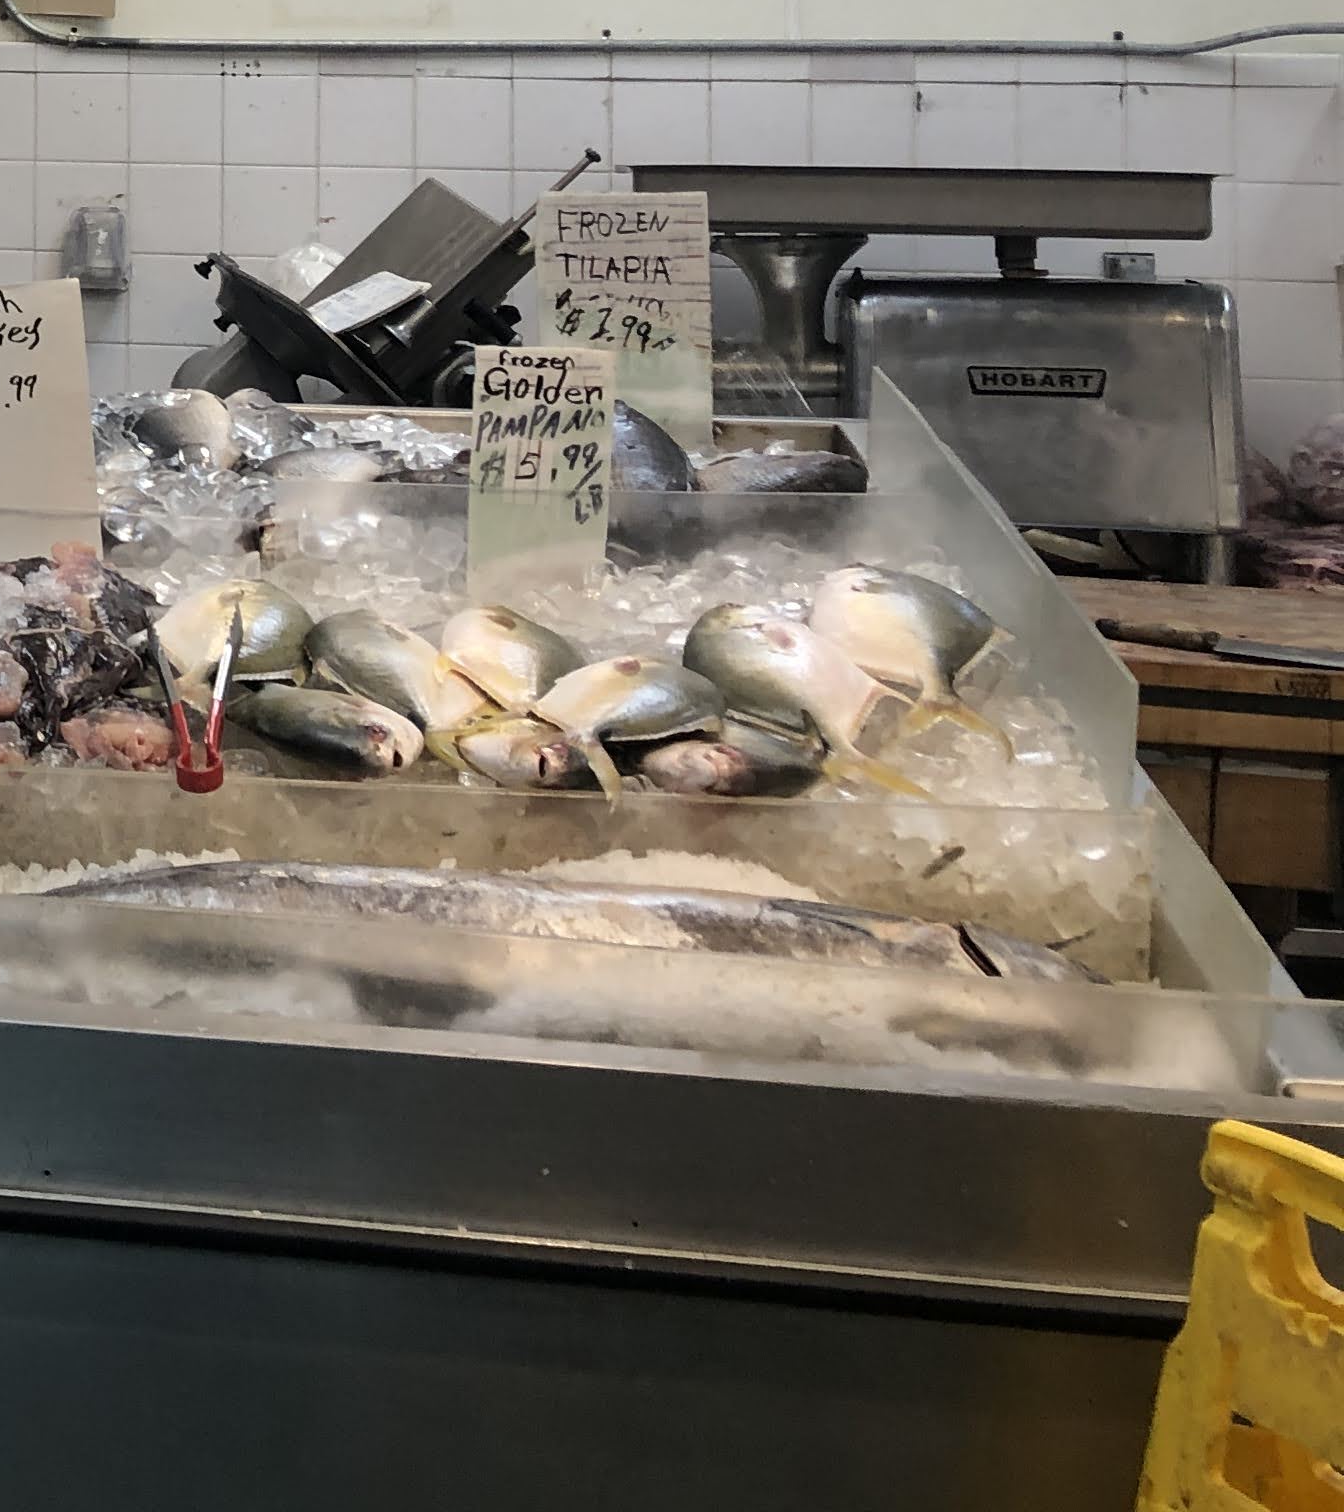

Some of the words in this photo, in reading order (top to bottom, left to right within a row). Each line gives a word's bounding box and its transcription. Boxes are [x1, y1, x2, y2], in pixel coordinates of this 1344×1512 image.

[557, 209, 669, 242] FROZEN
[555, 253, 672, 285] TILAPIA
[981, 372, 1094, 388] HOBART
